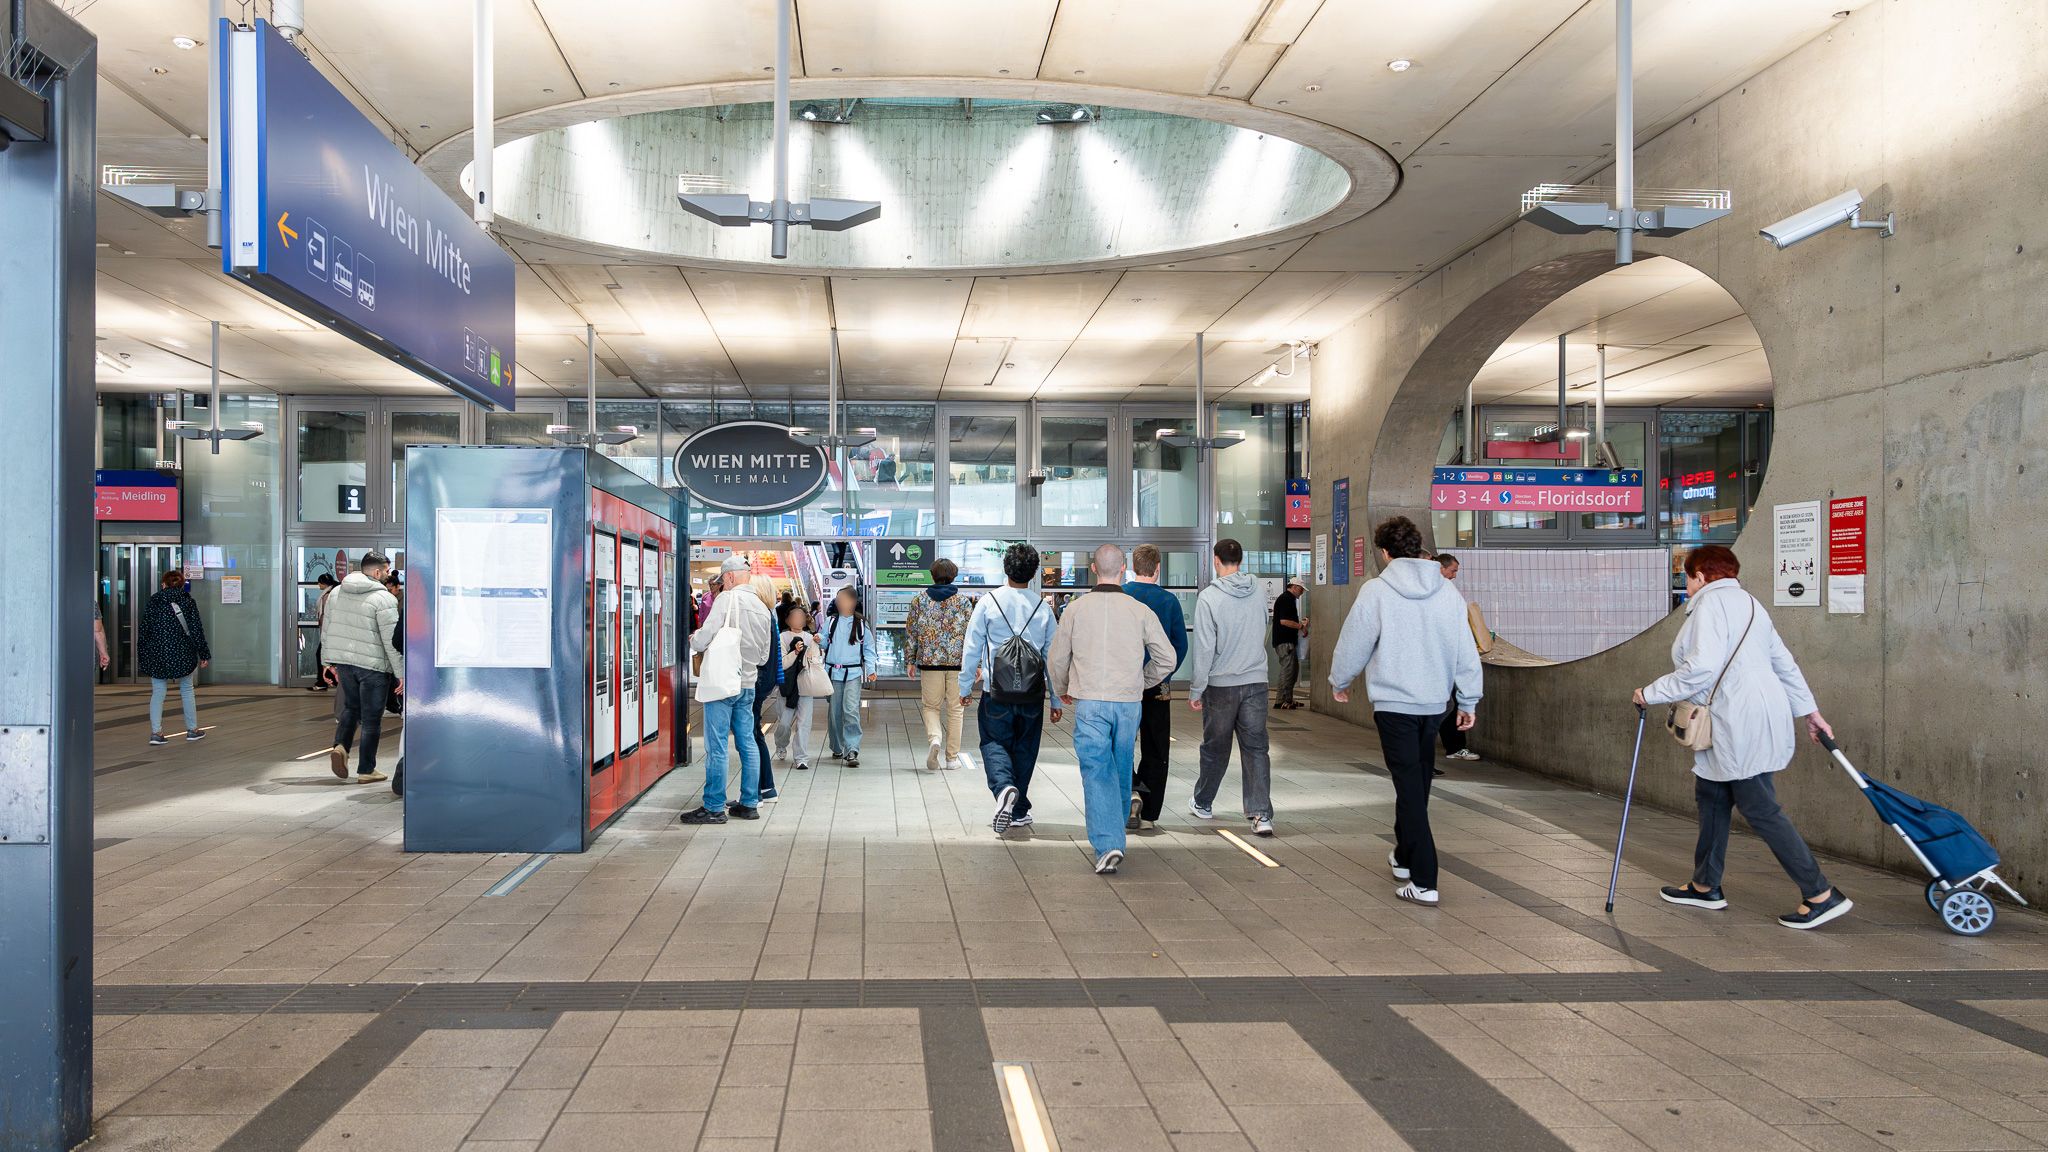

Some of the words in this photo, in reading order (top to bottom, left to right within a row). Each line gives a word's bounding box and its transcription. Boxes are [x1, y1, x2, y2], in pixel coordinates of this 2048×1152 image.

[365, 164, 419, 256] Wien
[426, 218, 471, 295] Mitte
[691, 454, 743, 469] WIEN
[751, 454, 811, 469] MITTE
[714, 474, 741, 484] THE
[750, 474, 788, 484] MALL
[1621, 474, 1627, 482] 5
[122, 491, 166, 503] Meidling
[1538, 490, 1631, 506] Floridsdorf
